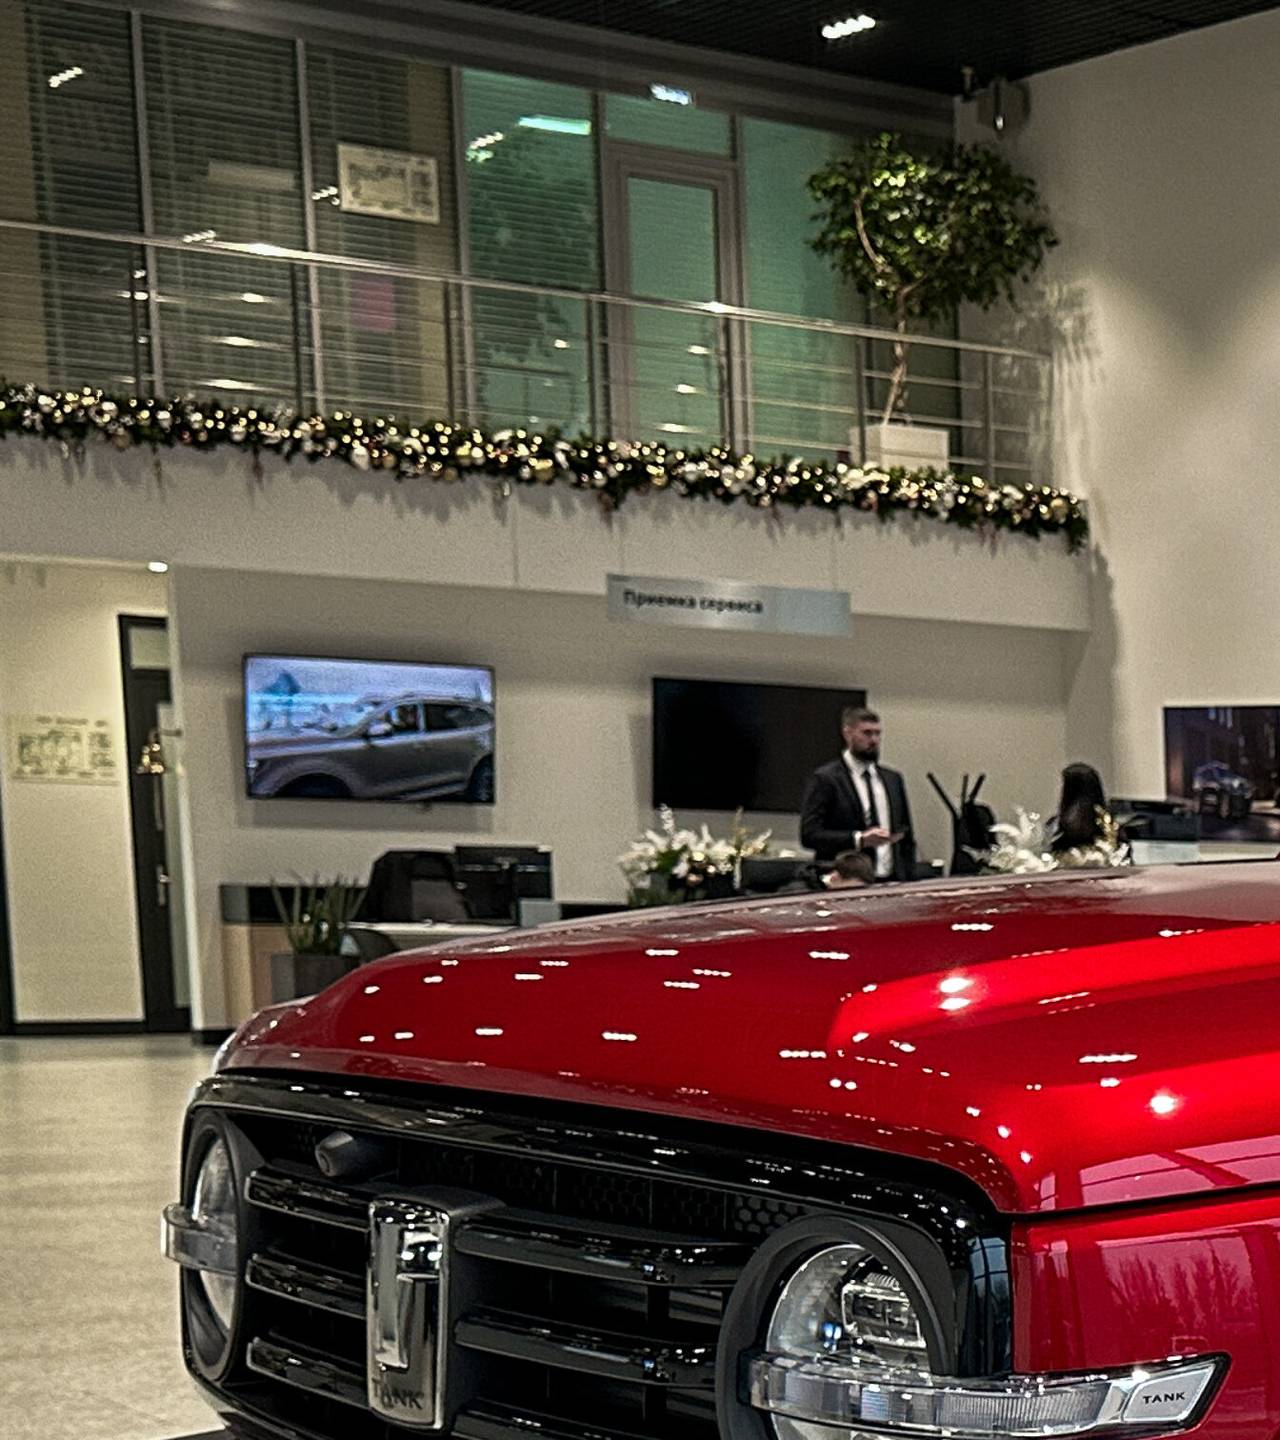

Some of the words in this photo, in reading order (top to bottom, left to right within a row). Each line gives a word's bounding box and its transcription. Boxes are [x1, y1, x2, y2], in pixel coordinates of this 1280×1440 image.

[623, 588, 697, 609] Приемка
[372, 1378, 424, 1410] TANK
[1143, 1392, 1185, 1404] TANK
